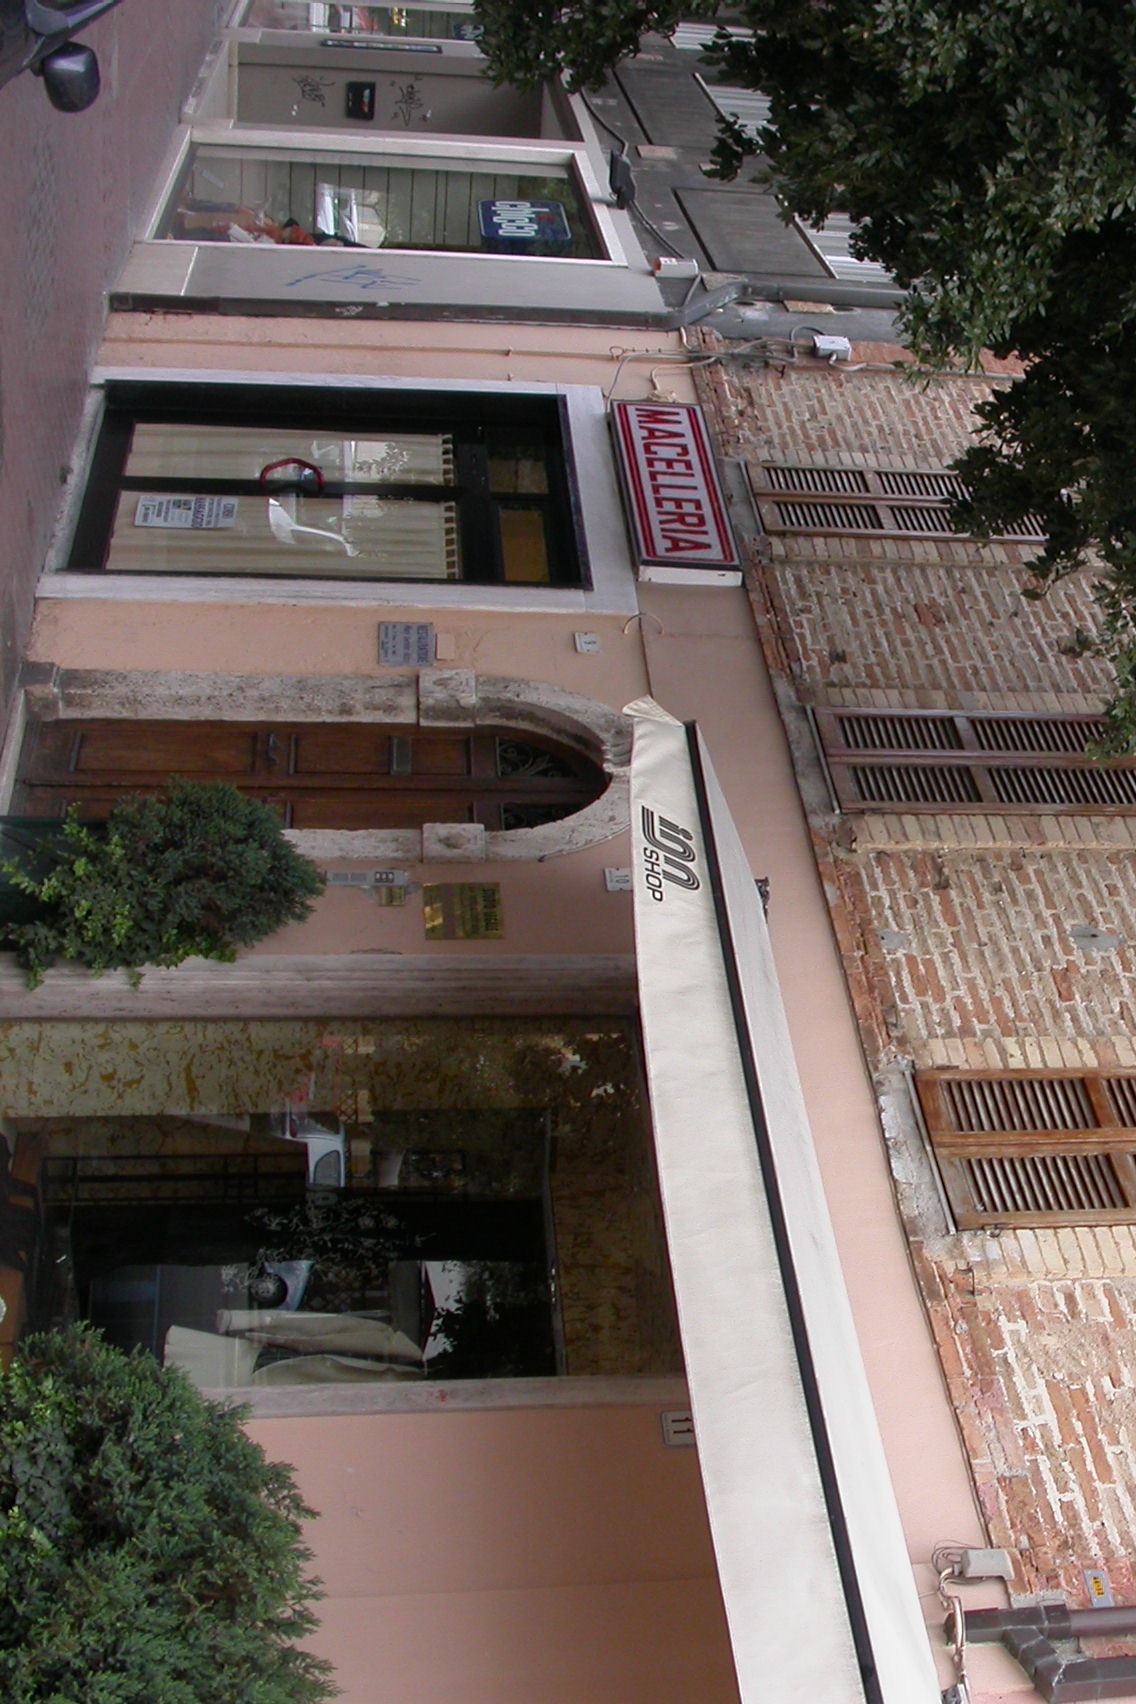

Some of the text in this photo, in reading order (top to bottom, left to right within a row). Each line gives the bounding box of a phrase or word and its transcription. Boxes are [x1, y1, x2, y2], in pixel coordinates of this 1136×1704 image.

[492, 201, 554, 237] chicco
[635, 407, 712, 553] MACELLERIA
[643, 847, 663, 902] SHOP
[672, 1417, 694, 1434] 11
